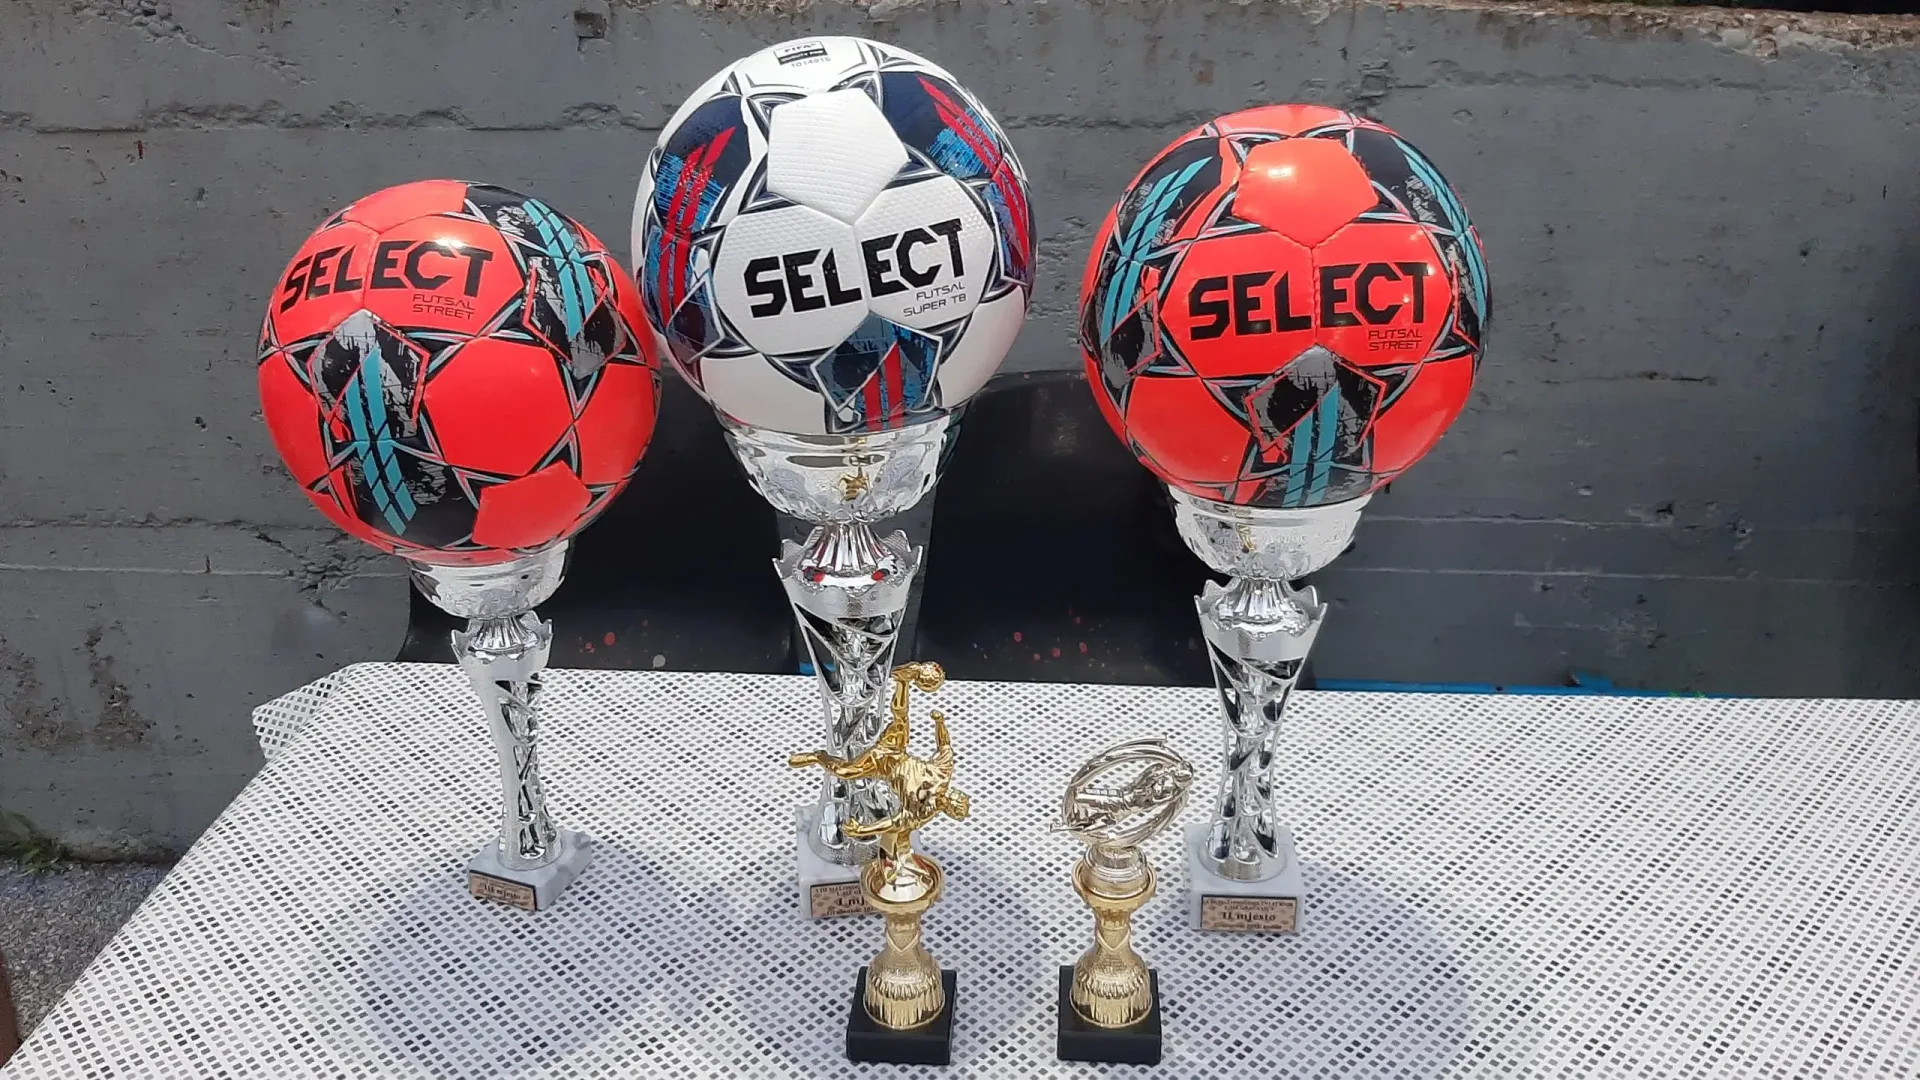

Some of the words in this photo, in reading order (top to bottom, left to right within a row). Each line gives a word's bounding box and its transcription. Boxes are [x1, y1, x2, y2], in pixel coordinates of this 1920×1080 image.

[744, 217, 966, 318] SELECT
[280, 240, 494, 315] SELECT
[915, 281, 966, 302] FUTSAL
[412, 294, 476, 311] FUTSAL
[903, 299, 947, 317] SUPER
[1188, 261, 1429, 342] SELECT
[411, 303, 475, 321] STREET
[1368, 328, 1423, 340] FUTSAL
[1368, 339, 1423, 352] STREET
